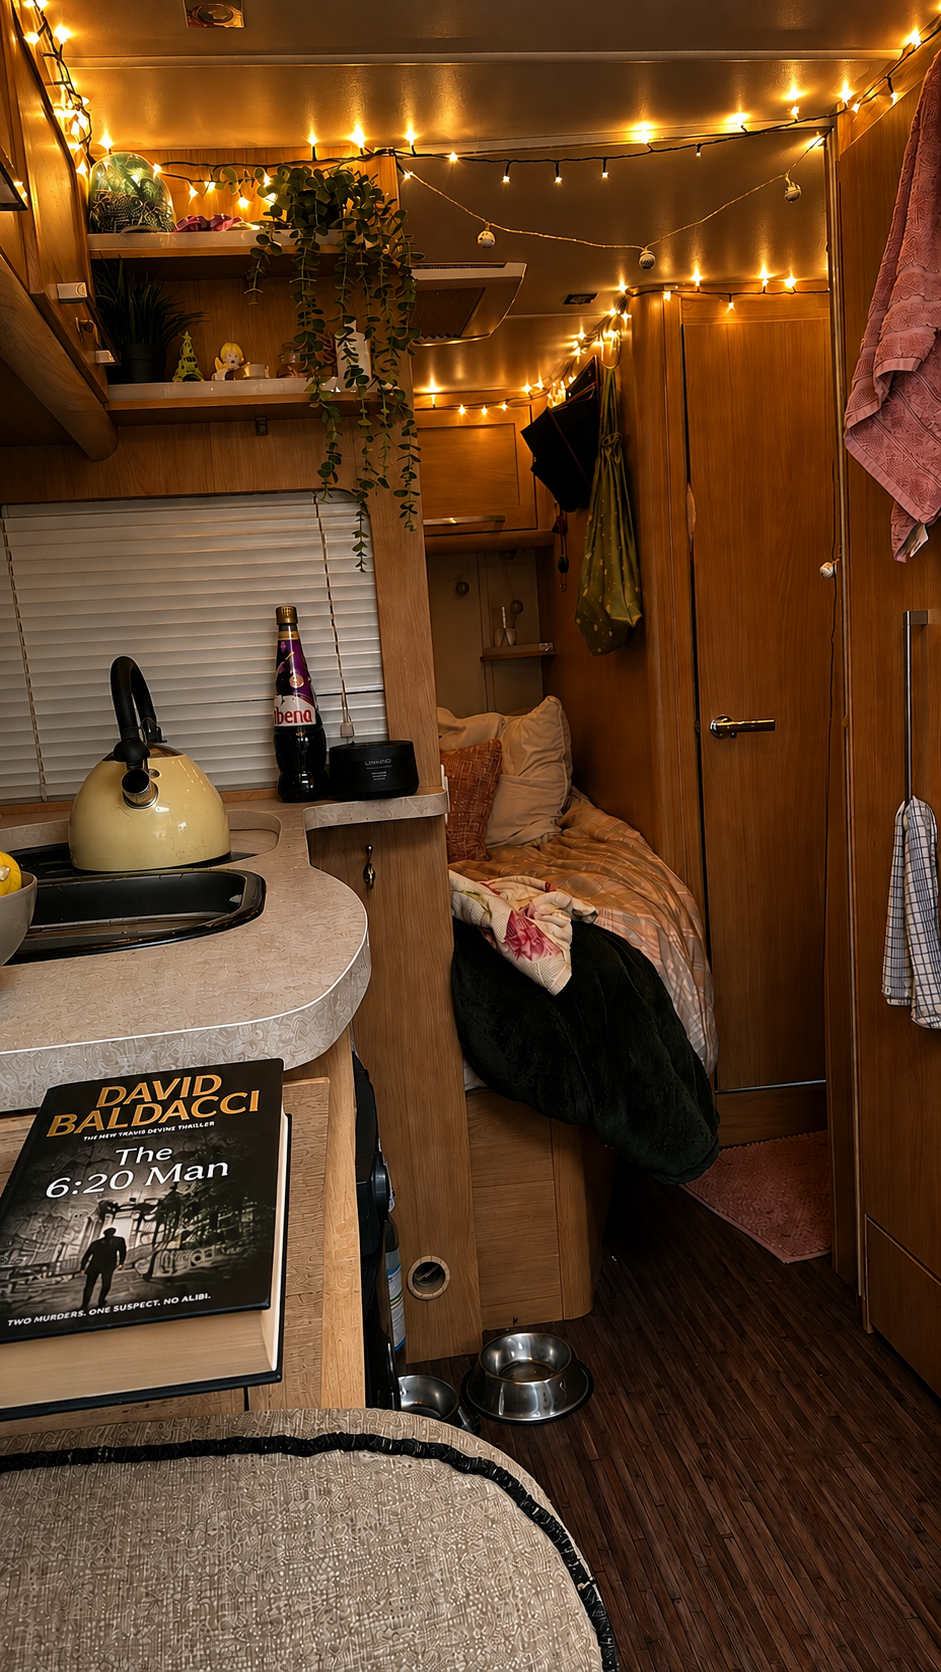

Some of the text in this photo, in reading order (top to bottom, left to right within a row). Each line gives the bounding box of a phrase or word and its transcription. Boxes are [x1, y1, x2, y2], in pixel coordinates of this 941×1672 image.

[96, 1074, 222, 1108] DAVID
[46, 1090, 260, 1137] BALDACCI
[98, 1132, 117, 1140] NEW
[118, 1129, 146, 1137] TRAVIS
[147, 1126, 176, 1134] DEVINE
[177, 1121, 215, 1131] THRILLER
[115, 1146, 173, 1167] The
[45, 1161, 229, 1199] 6:20 Man
[7, 1292, 212, 1327] TWO MURDERS. ONE SUSPECT. NO ALIBI.
